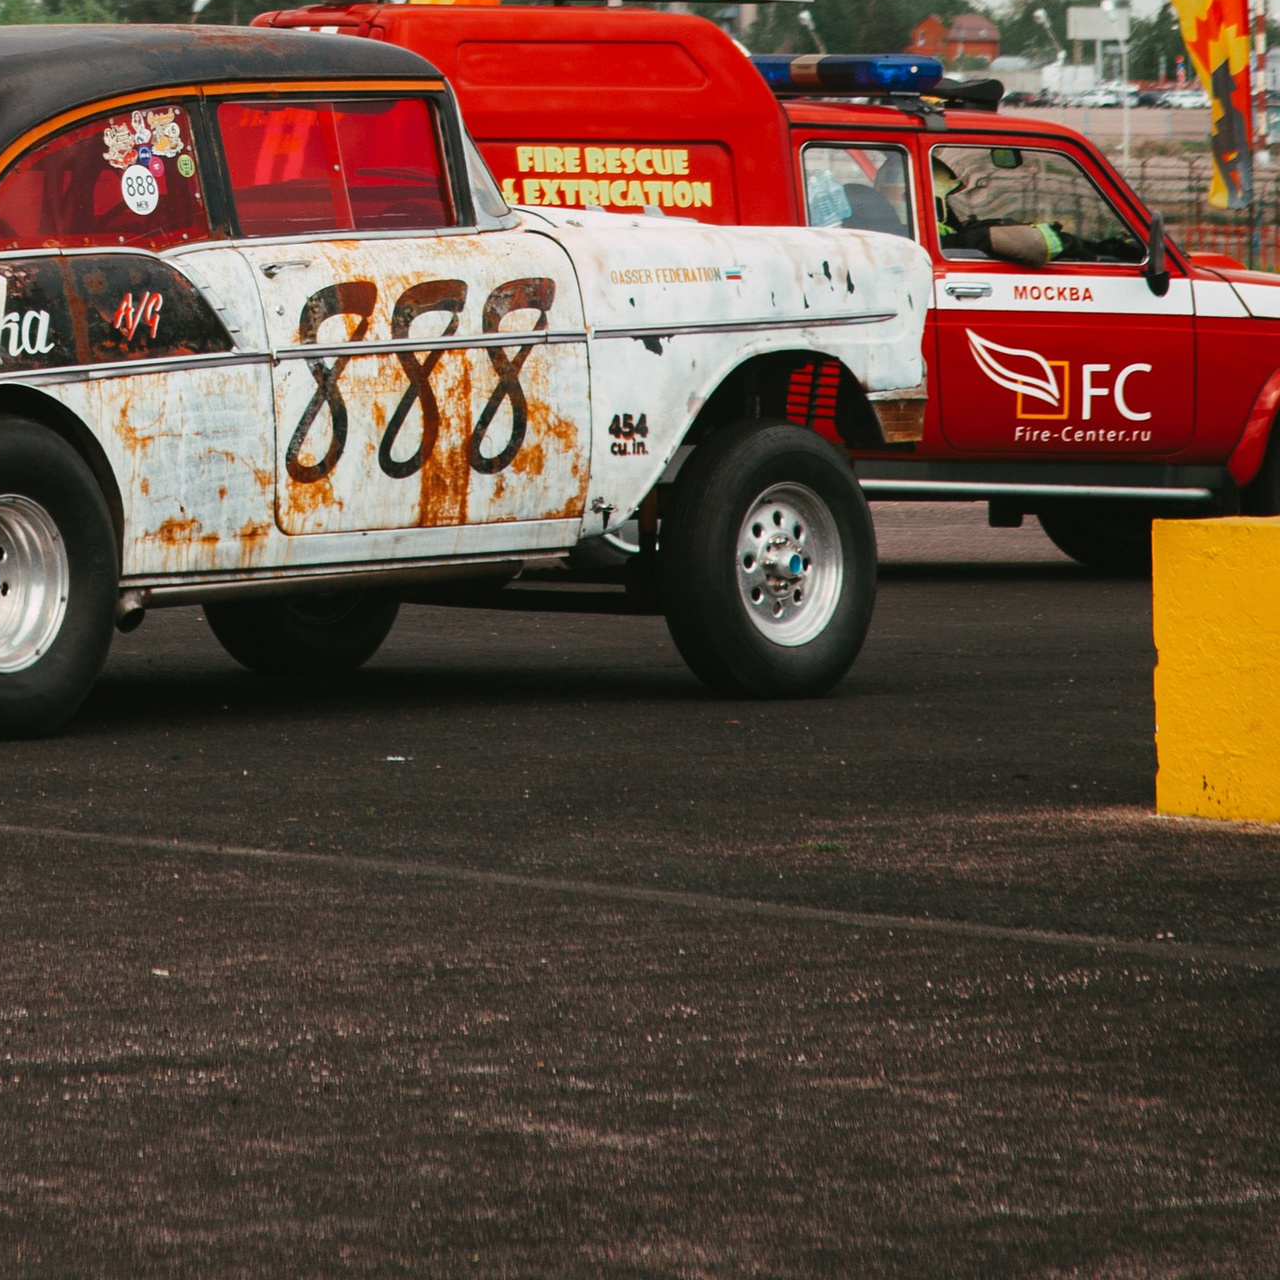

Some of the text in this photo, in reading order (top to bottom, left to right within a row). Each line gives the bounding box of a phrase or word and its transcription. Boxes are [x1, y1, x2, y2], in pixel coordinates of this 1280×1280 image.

[516, 146, 690, 175] FIRE RESCUE
[125, 175, 156, 197] 888
[522, 178, 713, 208] EXTRICATION
[610, 267, 722, 285] GASSER FEDERATION
[1013, 285, 1094, 302] МОСКВА
[285, 276, 556, 484] 888
[1082, 362, 1152, 421] FC
[608, 413, 649, 440] 454
[1014, 425, 1152, 442] Fire-Center.ru
